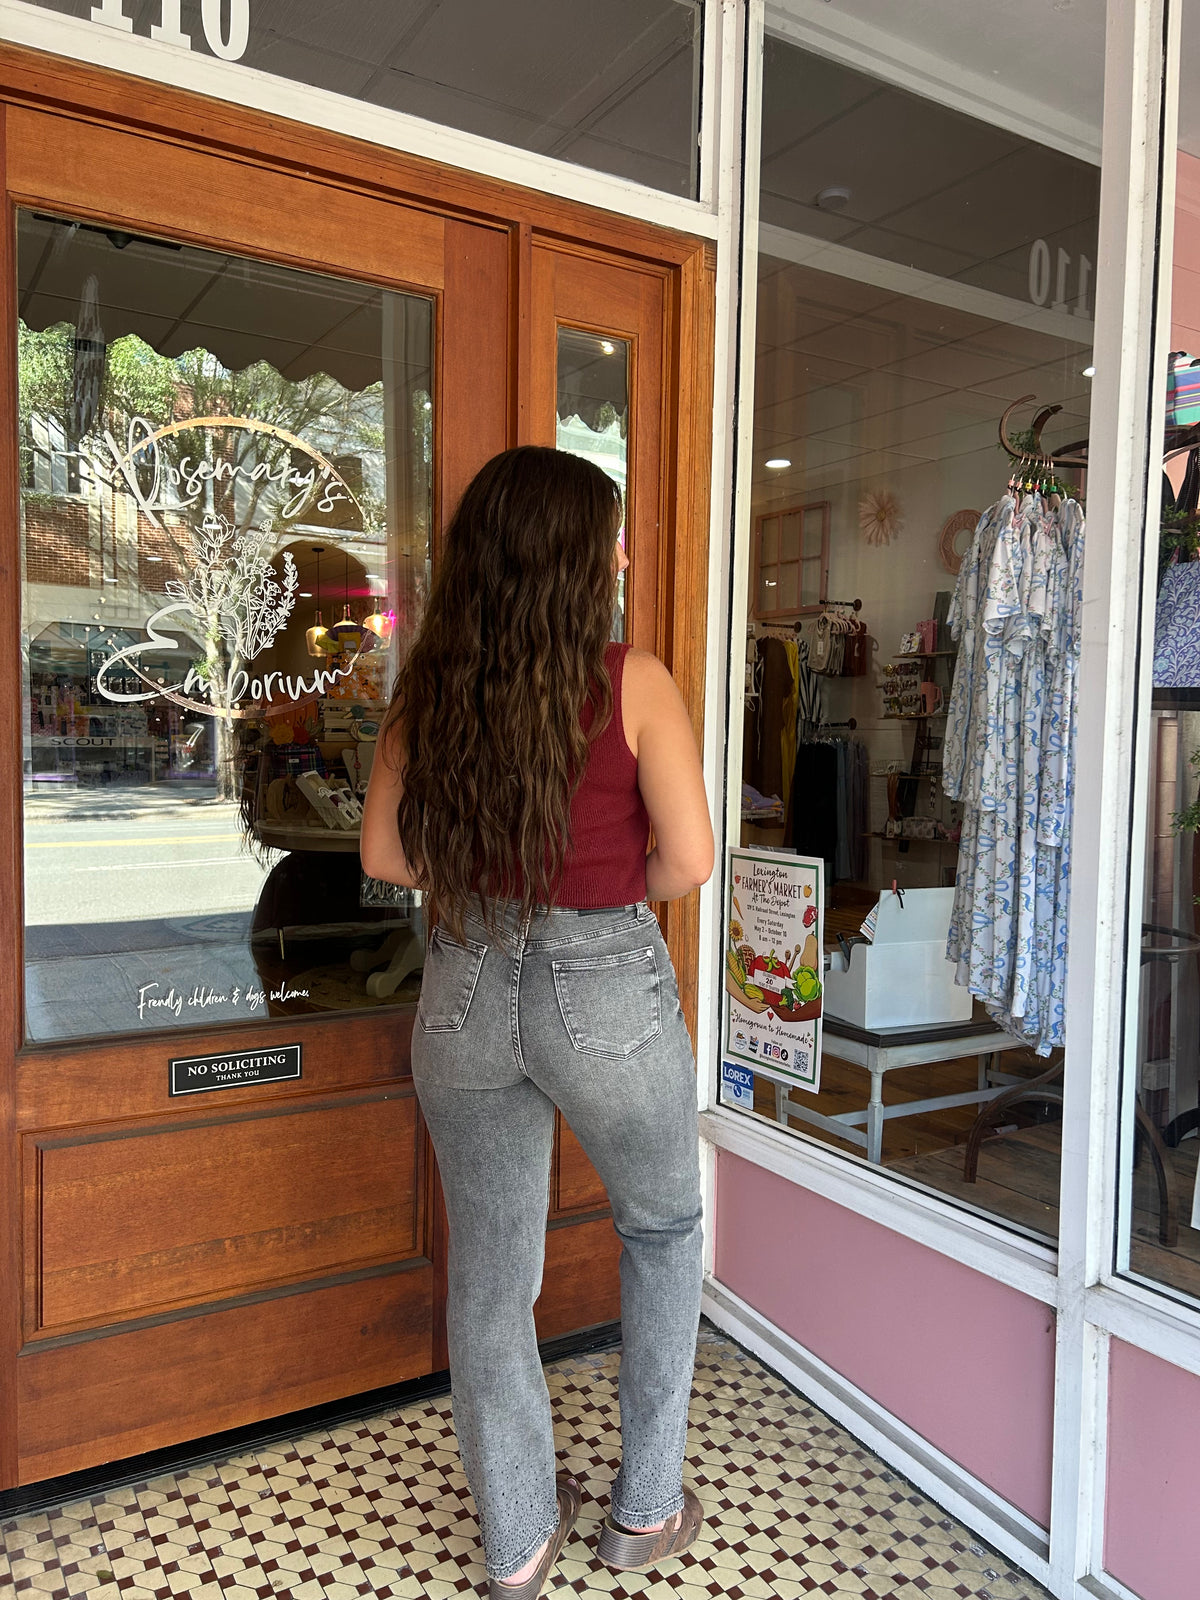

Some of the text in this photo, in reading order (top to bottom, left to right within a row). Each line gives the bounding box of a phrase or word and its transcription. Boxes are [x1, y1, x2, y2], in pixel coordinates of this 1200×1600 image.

[104, 416, 348, 528] Rosemary's
[97, 602, 354, 728] Emporium
[51, 737, 116, 747] SCOUT
[753, 863, 788, 883] Lexington
[741, 876, 802, 899] FARMER'S MARKET
[752, 892, 790, 910] At The Depot
[757, 916, 784, 930] Every Saturday
[767, 927, 782, 937] October
[231, 986, 241, 1006] &
[245, 985, 267, 1011] dogs
[735, 1012, 768, 1031] Homegrown
[768, 1023, 775, 1033] to
[775, 1025, 809, 1045] Homemade
[187, 1054, 287, 1077] NO SOLICITING
[216, 1069, 260, 1081] THANK YOU
[724, 1066, 752, 1087] LOREX
